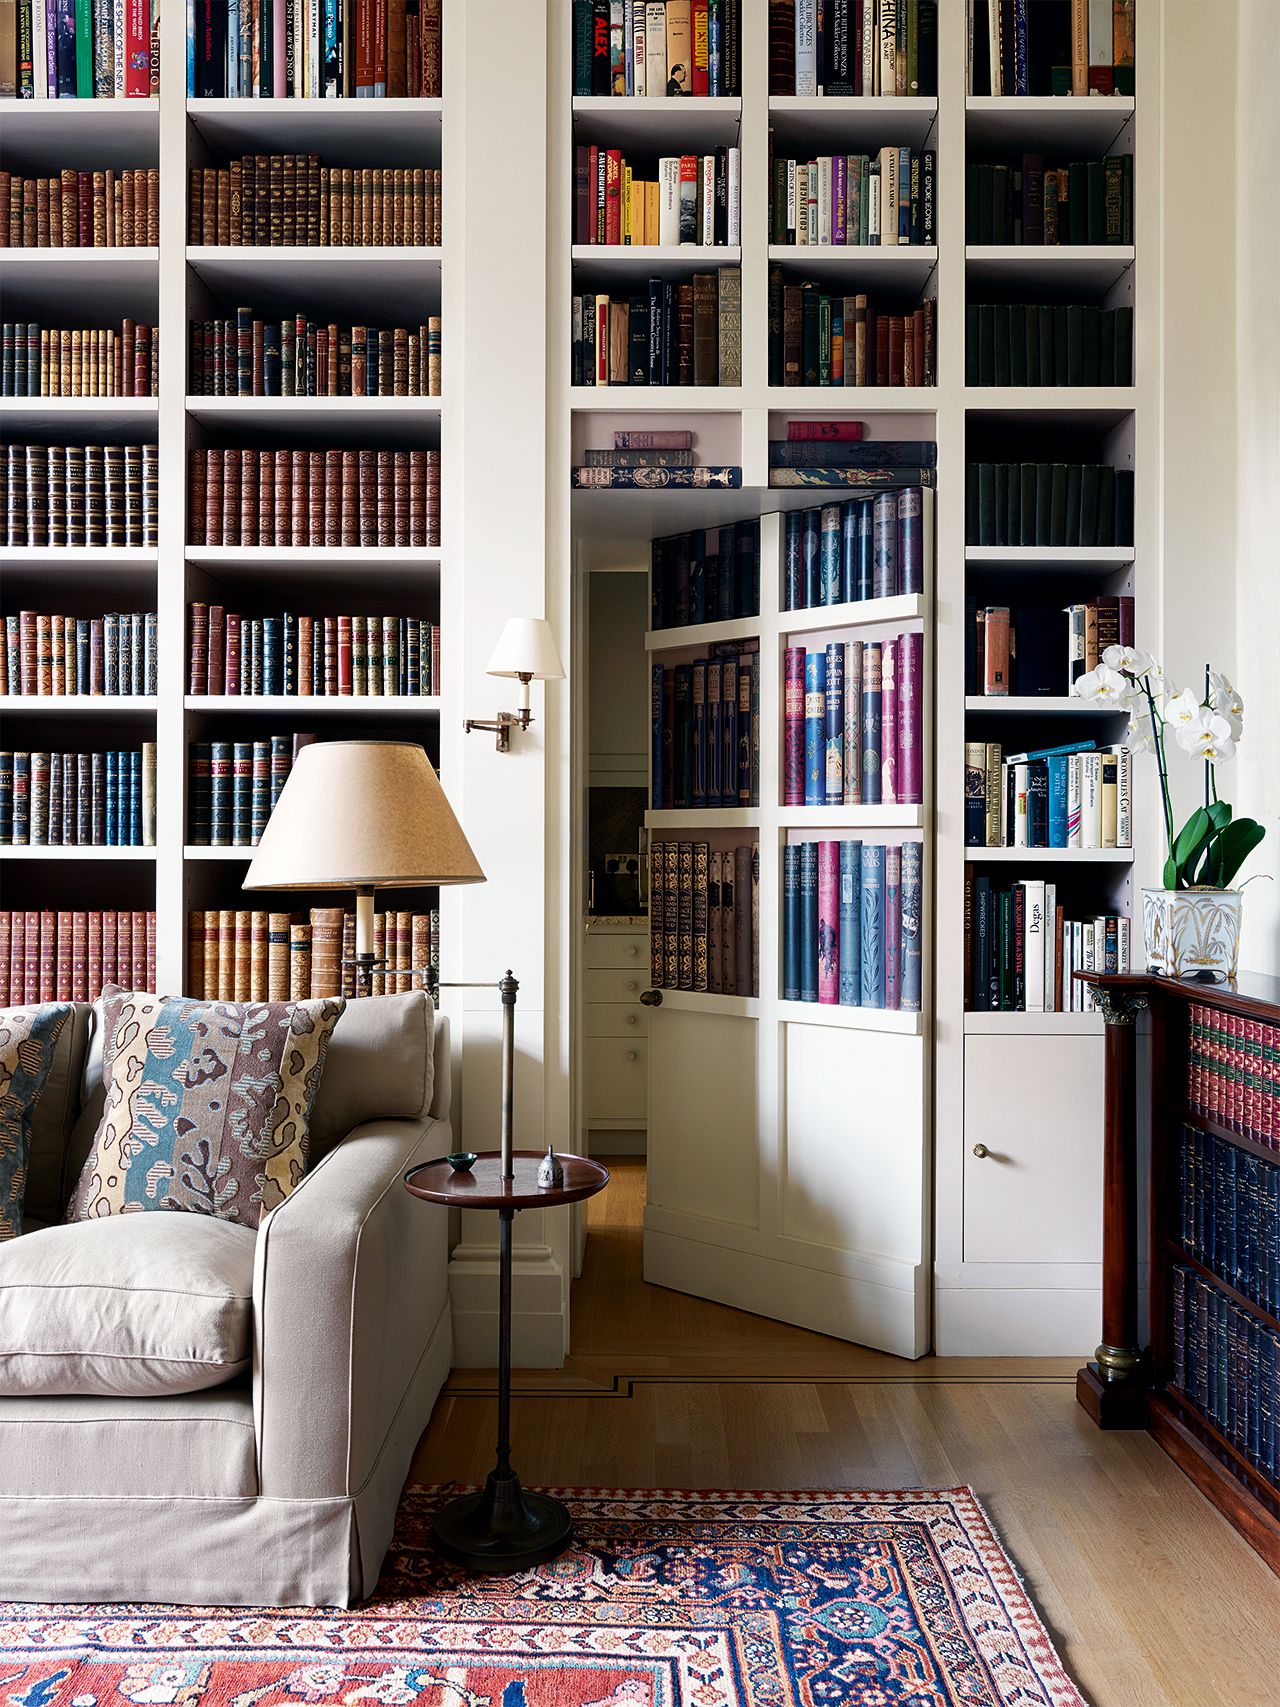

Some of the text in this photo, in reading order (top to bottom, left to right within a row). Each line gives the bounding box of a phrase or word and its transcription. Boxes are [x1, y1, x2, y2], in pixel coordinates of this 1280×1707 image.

[116, 40, 123, 52] OF
[594, 17, 608, 57] ALEX
[695, 12, 708, 68] SIDESHOW
[636, 45, 644, 65] JENKINS
[1017, 63, 1026, 92] Henri
[705, 160, 713, 187] Kingsley
[1120, 747, 1130, 814] DARCONVILLE'S CAT
[992, 814, 999, 824] TO
[1030, 904, 1043, 933] Degas
